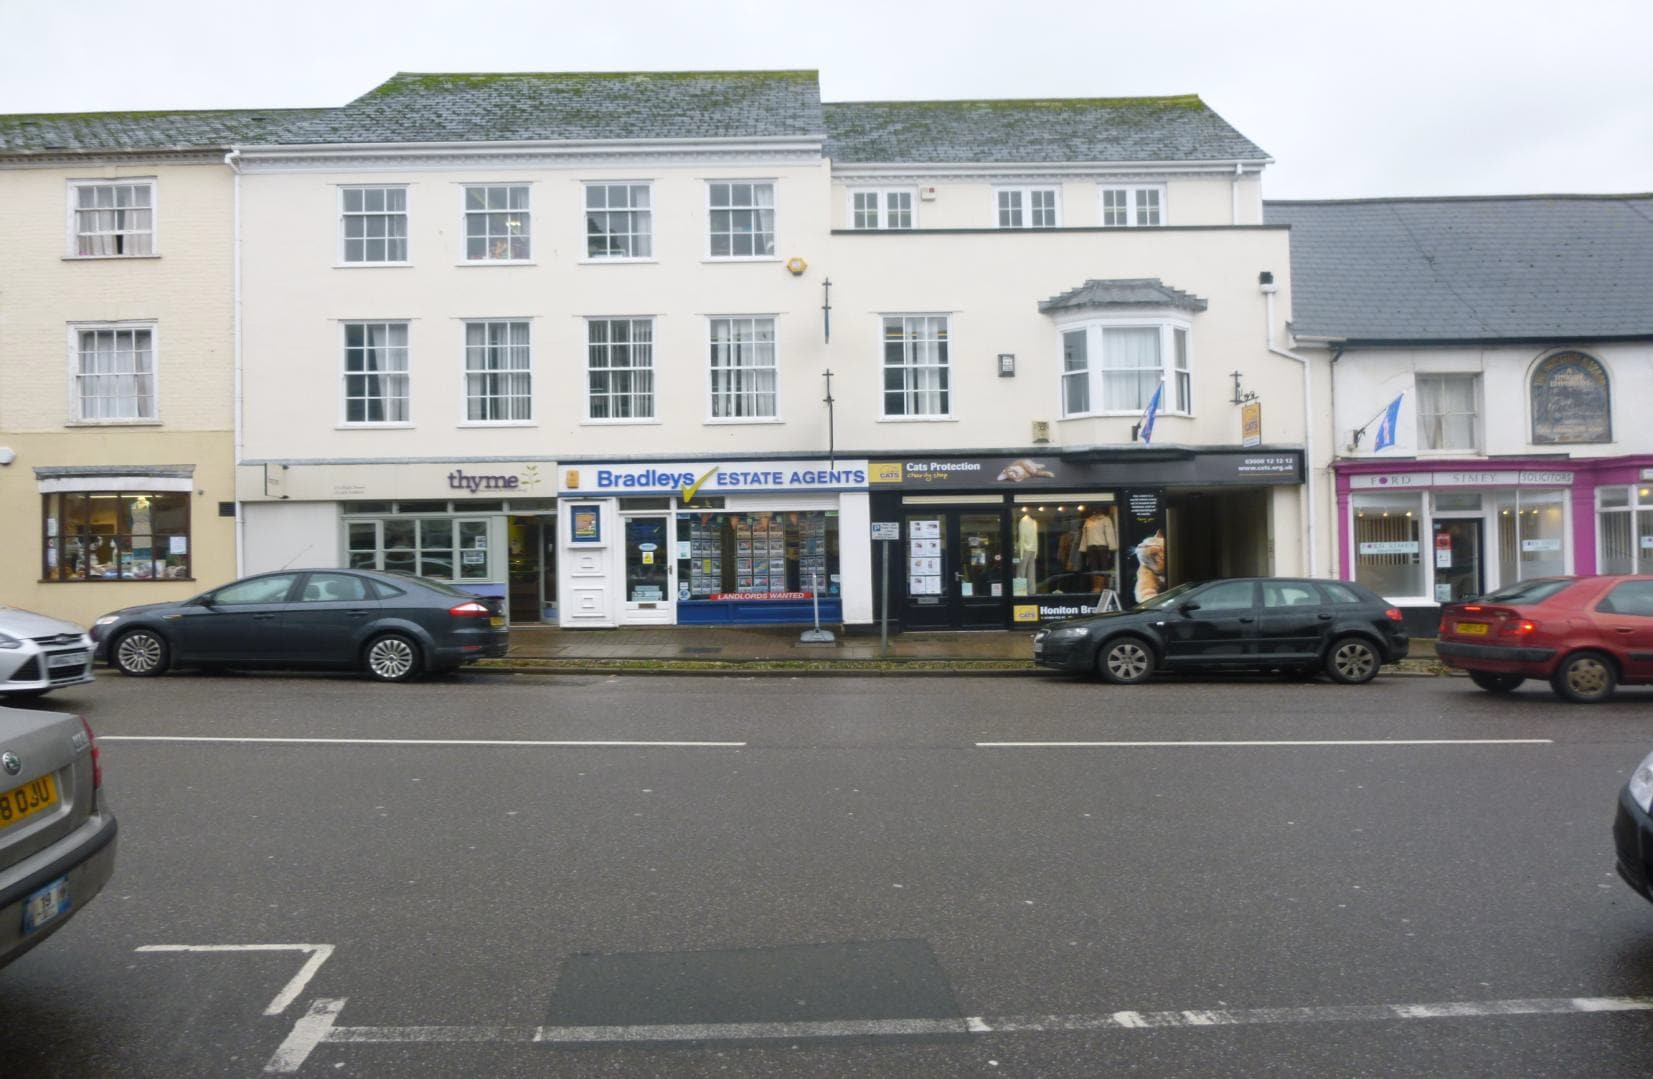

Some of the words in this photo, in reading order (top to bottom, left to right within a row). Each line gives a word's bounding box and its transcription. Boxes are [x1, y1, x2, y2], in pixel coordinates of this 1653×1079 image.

[906, 462, 928, 471] Cats
[930, 462, 981, 471] Protection
[448, 469, 519, 493] thyme
[597, 469, 695, 489] Bradleys
[716, 471, 783, 485] ESTATE
[789, 470, 865, 484] AGENTS
[1521, 471, 1571, 482] SOLICITORS
[718, 592, 768, 600] LANDLORDS
[769, 591, 804, 599] WANTED
[1040, 605, 1078, 615] Honiton
